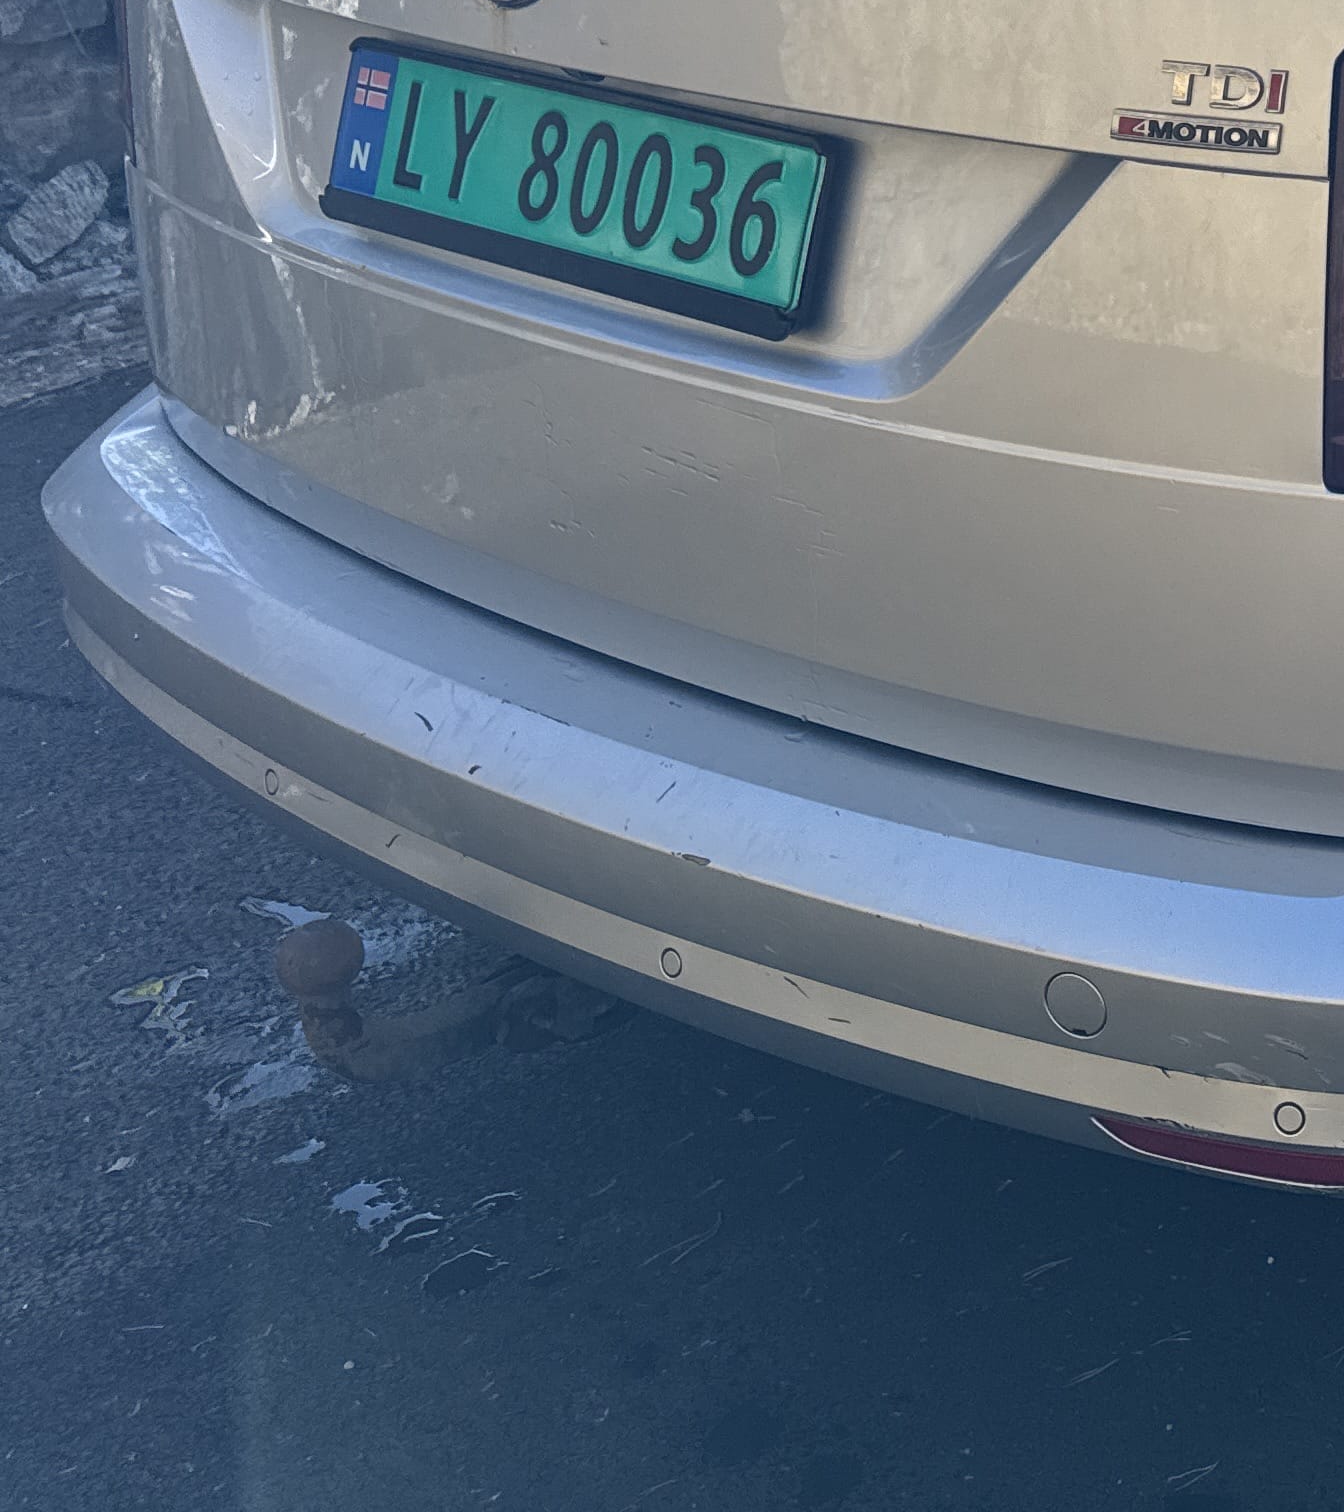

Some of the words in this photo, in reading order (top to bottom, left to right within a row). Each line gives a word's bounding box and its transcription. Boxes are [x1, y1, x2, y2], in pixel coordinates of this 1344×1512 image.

[1161, 59, 1289, 114] TDI
[349, 138, 371, 173] N
[1131, 118, 1270, 148] 4MOTION
[393, 81, 495, 201] LY
[517, 111, 784, 277] 80036
